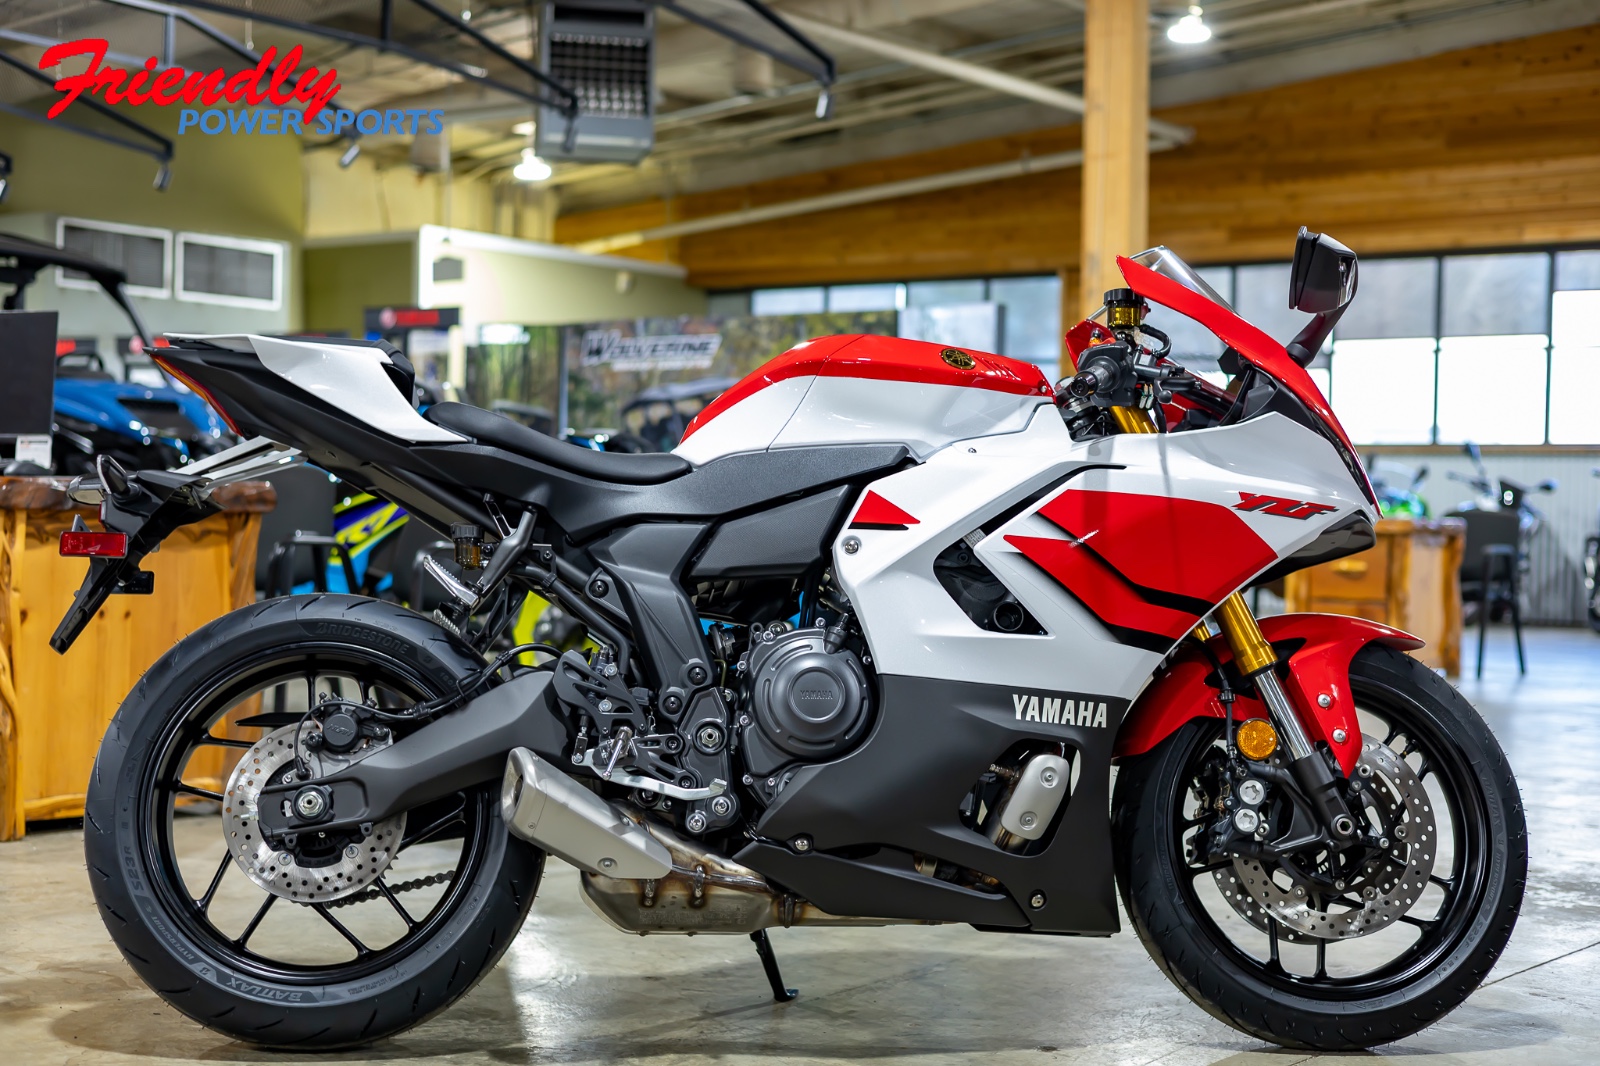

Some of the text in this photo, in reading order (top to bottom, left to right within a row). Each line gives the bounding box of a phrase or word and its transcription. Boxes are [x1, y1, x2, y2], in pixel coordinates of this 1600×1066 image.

[315, 622, 410, 654] BRIDGESTONE
[801, 690, 833, 700] YAMAHA
[1012, 693, 1107, 728] YAMAHA
[122, 845, 145, 891] S23R
[151, 915, 194, 961] HYPERSPORT
[226, 976, 303, 1001] BATTLAX
